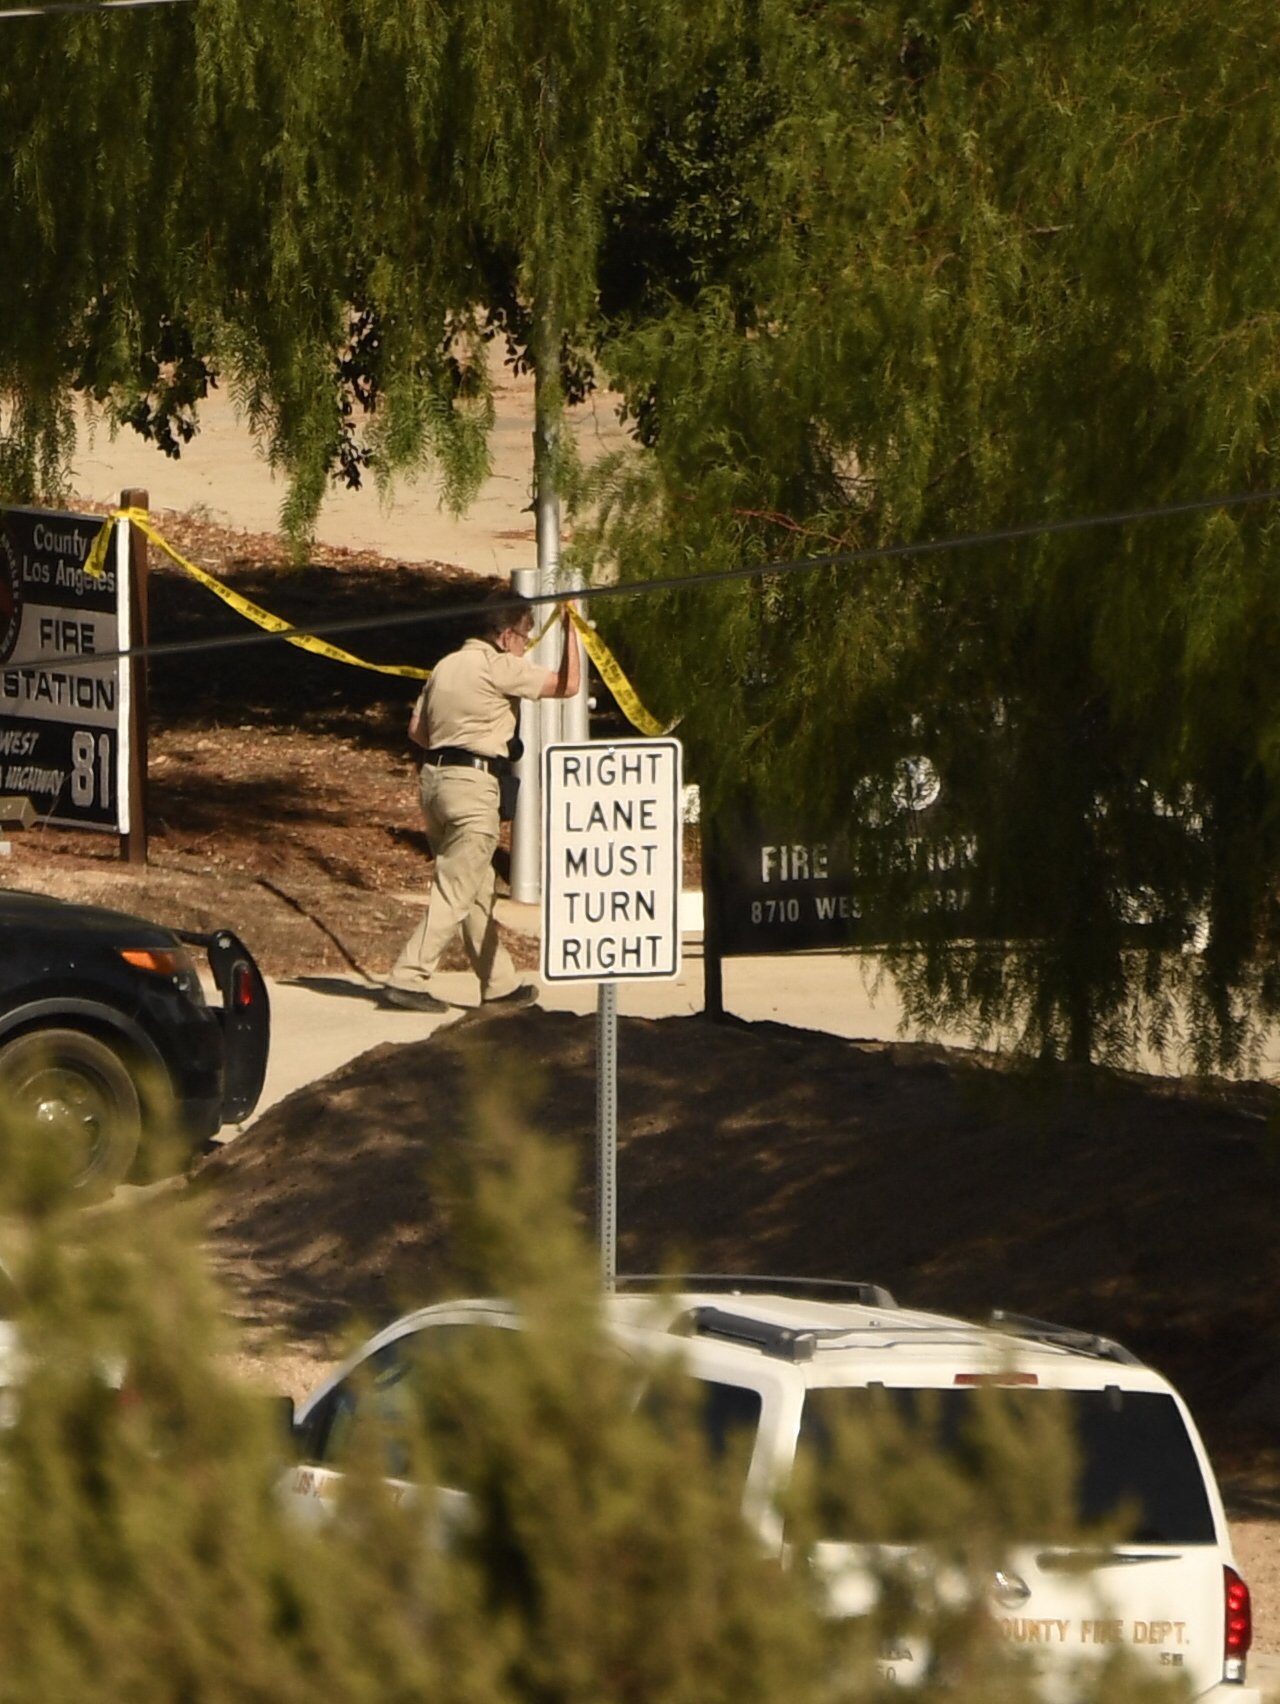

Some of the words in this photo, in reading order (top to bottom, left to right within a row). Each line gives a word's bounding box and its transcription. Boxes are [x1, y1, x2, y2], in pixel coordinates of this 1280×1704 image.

[33, 523, 87, 561] County
[23, 555, 50, 583] Los
[40, 618, 95, 653] FIRE
[2, 670, 115, 712] STATION
[0, 730, 39, 756] WEST
[5, 766, 65, 796] HIGHWAY
[71, 730, 110, 809] 81
[562, 753, 662, 787] RIGHT
[565, 799, 657, 832] LANE
[565, 844, 658, 878] MUST
[761, 843, 828, 883] FIRE
[563, 889, 655, 923] TURN
[751, 899, 800, 924] 8710
[816, 895, 870, 920] WES
[562, 935, 662, 969] RIGHT
[999, 1618, 1070, 1643] OUNTY
[1133, 1620, 1190, 1645] DEPT.
